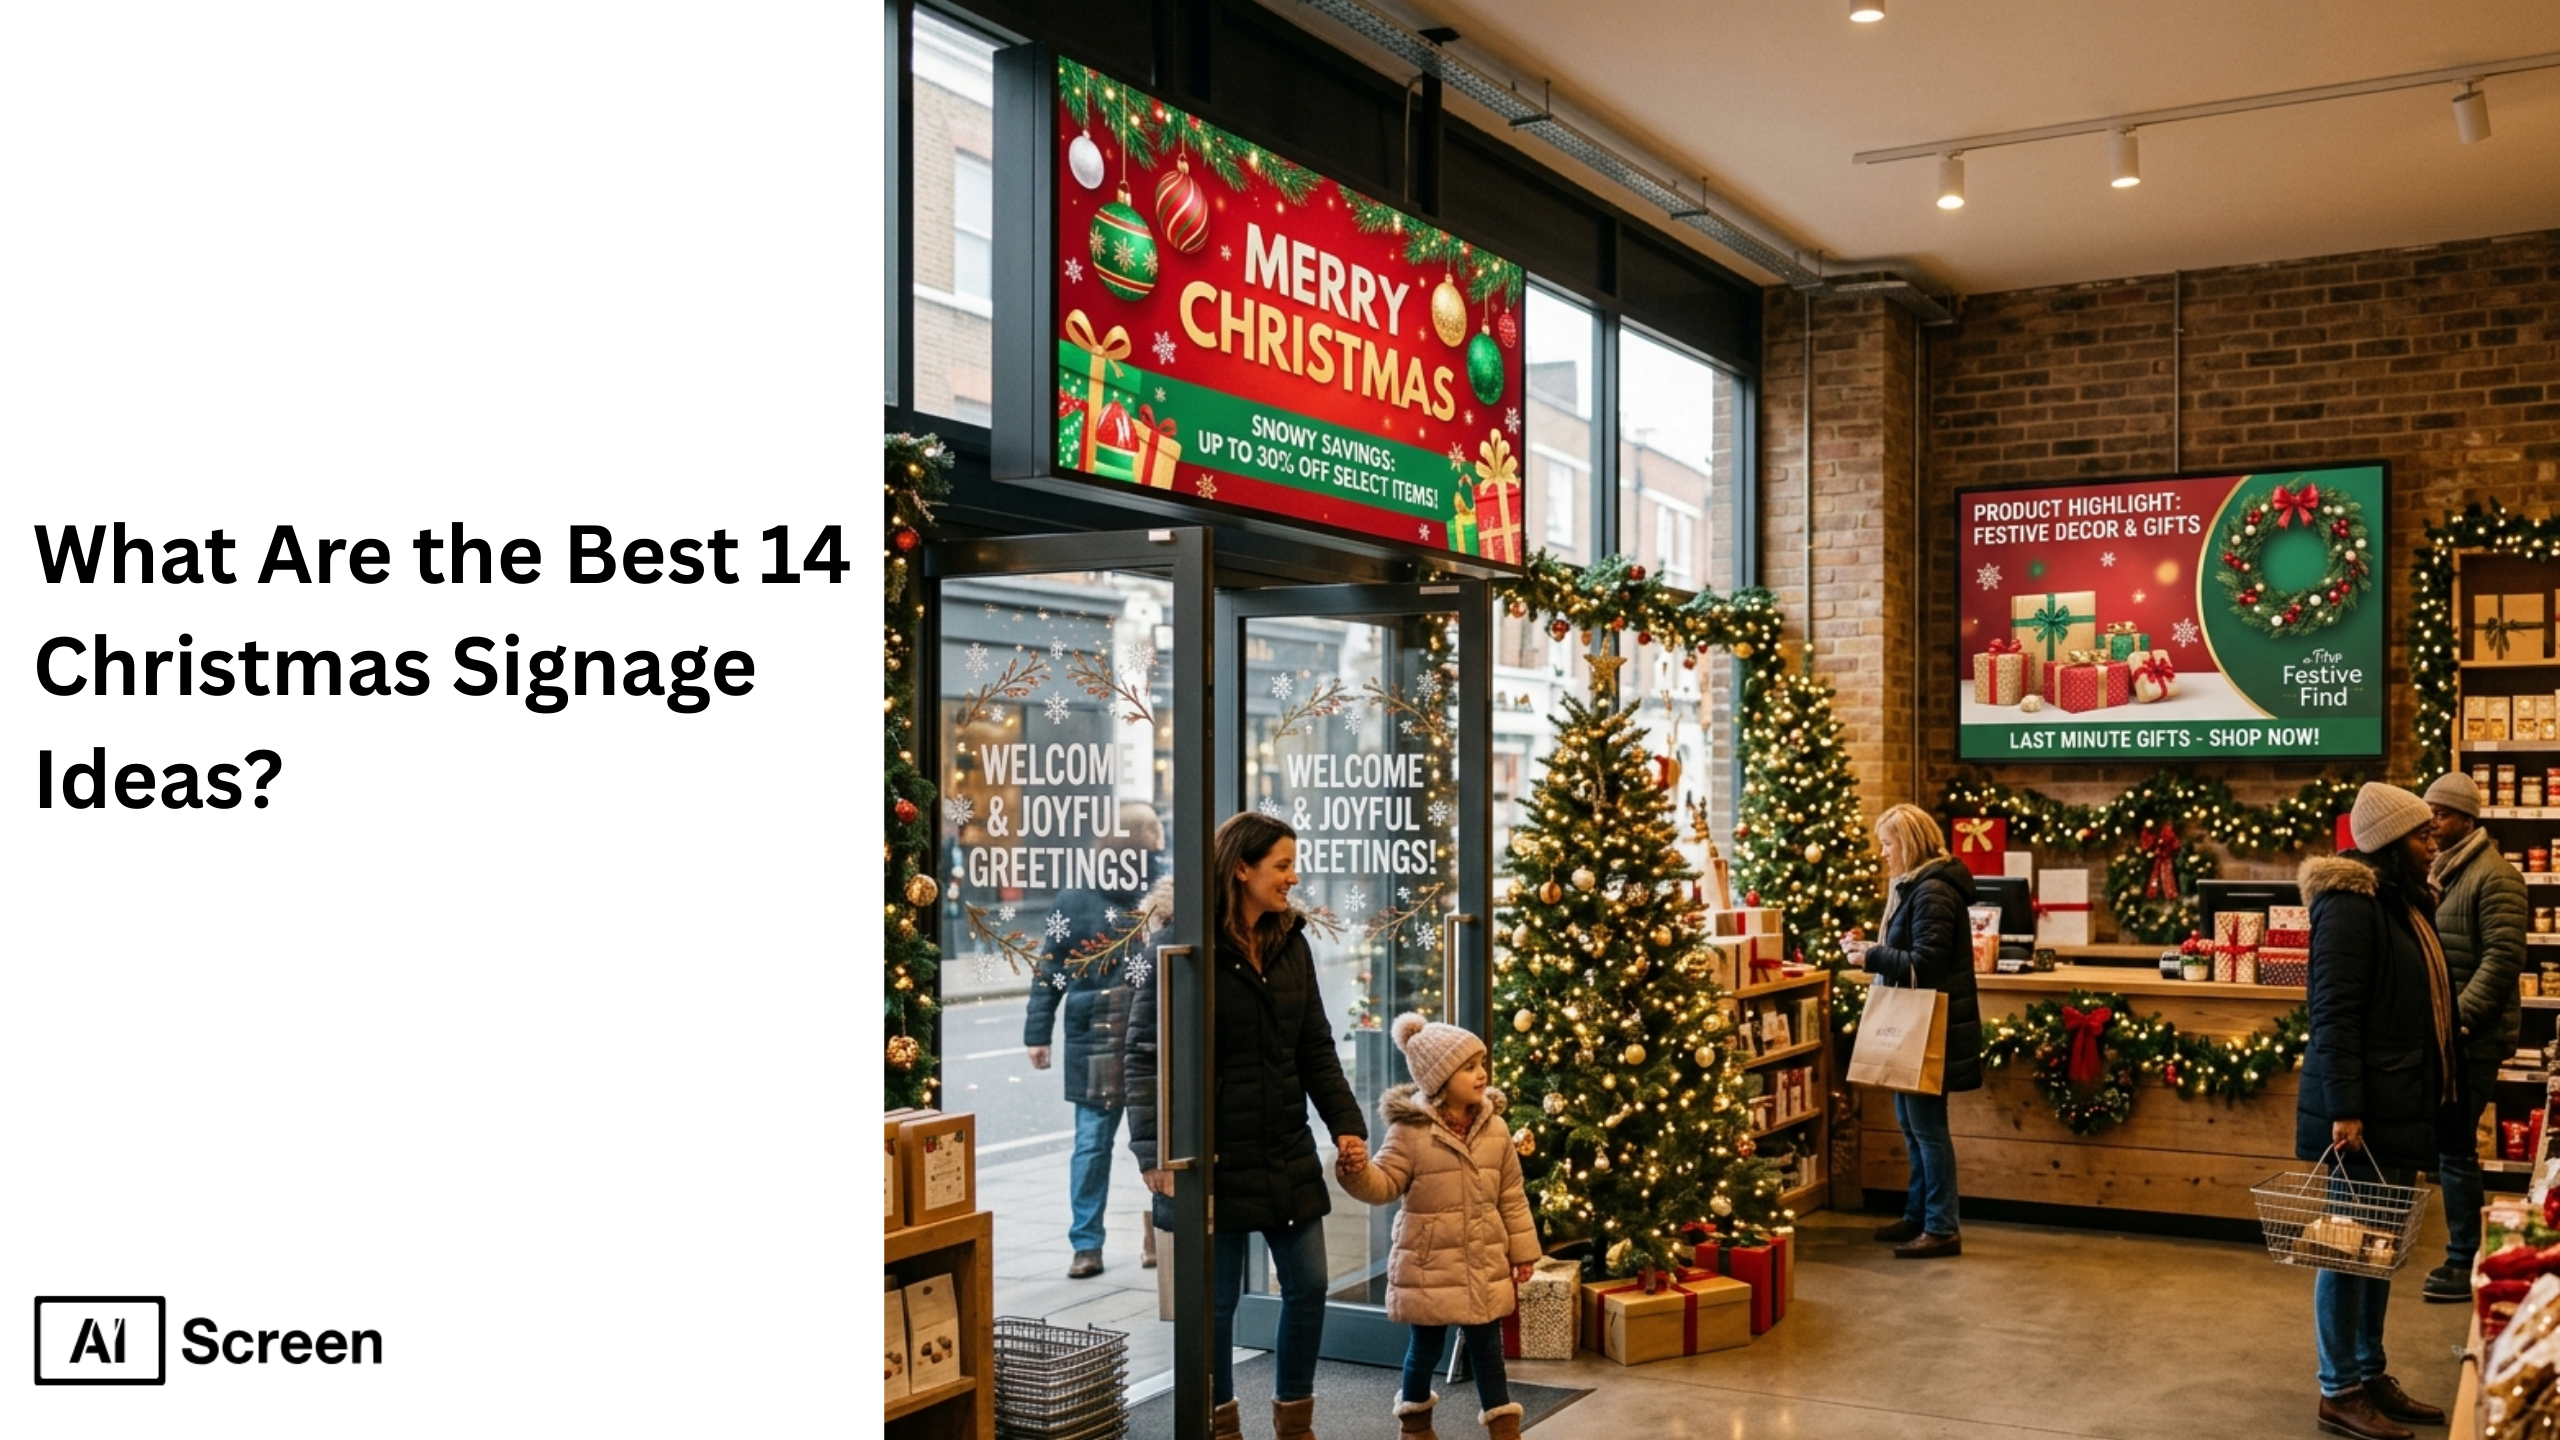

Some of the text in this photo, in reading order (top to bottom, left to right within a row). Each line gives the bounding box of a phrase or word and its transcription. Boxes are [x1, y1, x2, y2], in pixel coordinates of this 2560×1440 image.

[1244, 222, 1409, 336] MERRY
[1179, 281, 1455, 422] CHRISTMAS
[1251, 413, 1396, 472] SNOWY SAVINGS:
[1198, 430, 1438, 509] UP TO 30% OFF SELECT ITEMS!
[1973, 492, 2181, 522] PRODUCT HIGHLIGHT:
[1973, 514, 2201, 546] FESTIVE DECOR & GIFTS
[2283, 665, 2363, 685] Festive
[2301, 686, 2348, 707] Find
[2009, 731, 2056, 749] LAST
[2060, 731, 2132, 748] MINUTE
[2136, 730, 2191, 748] GIFTS
[2209, 729, 2262, 747] SHOP
[2267, 728, 2320, 746] NOW!
[981, 743, 1135, 785] WELCOME
[1287, 753, 1424, 788] WELCOME
[987, 795, 1131, 837] & JOYFUL
[1292, 796, 1420, 831] & JOYFUL
[968, 846, 1149, 891] GREETINGS!
[1293, 838, 1438, 875] REETINGS!
